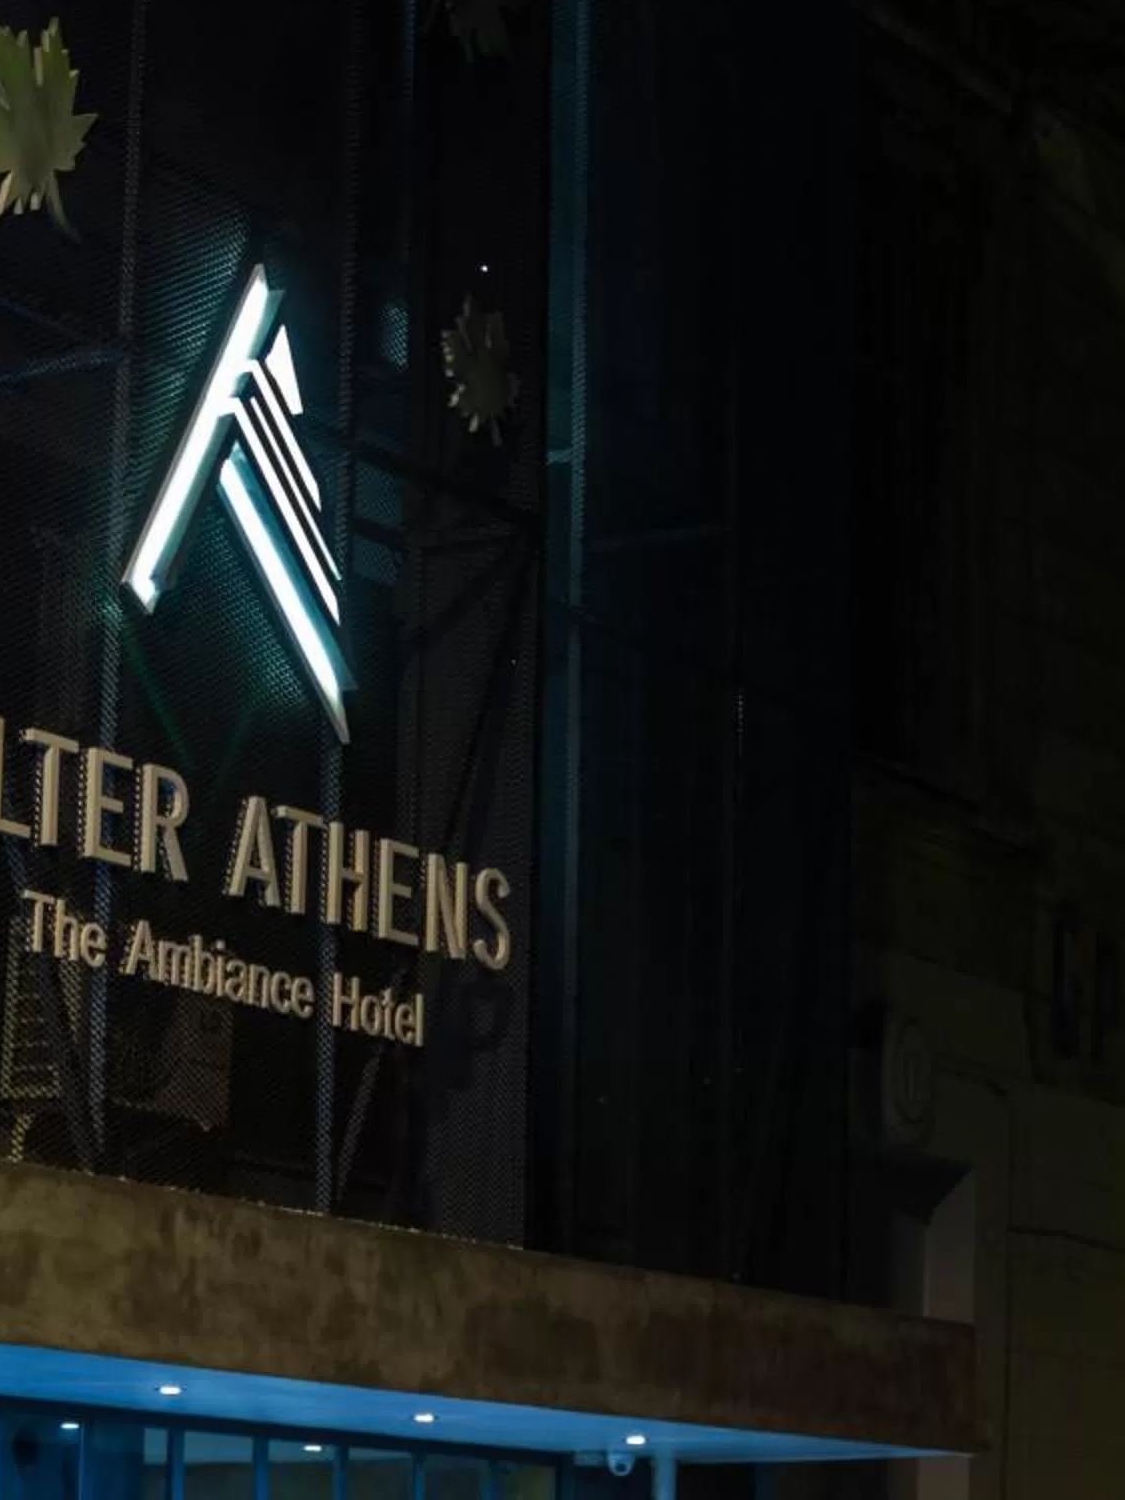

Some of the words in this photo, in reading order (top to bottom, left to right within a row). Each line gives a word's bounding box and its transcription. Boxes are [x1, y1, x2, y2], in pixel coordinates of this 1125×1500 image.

[223, 794, 513, 971] ATHENS
[22, 888, 107, 968] The
[119, 919, 315, 1019] Ambiance
[330, 970, 425, 1048] Hotel
